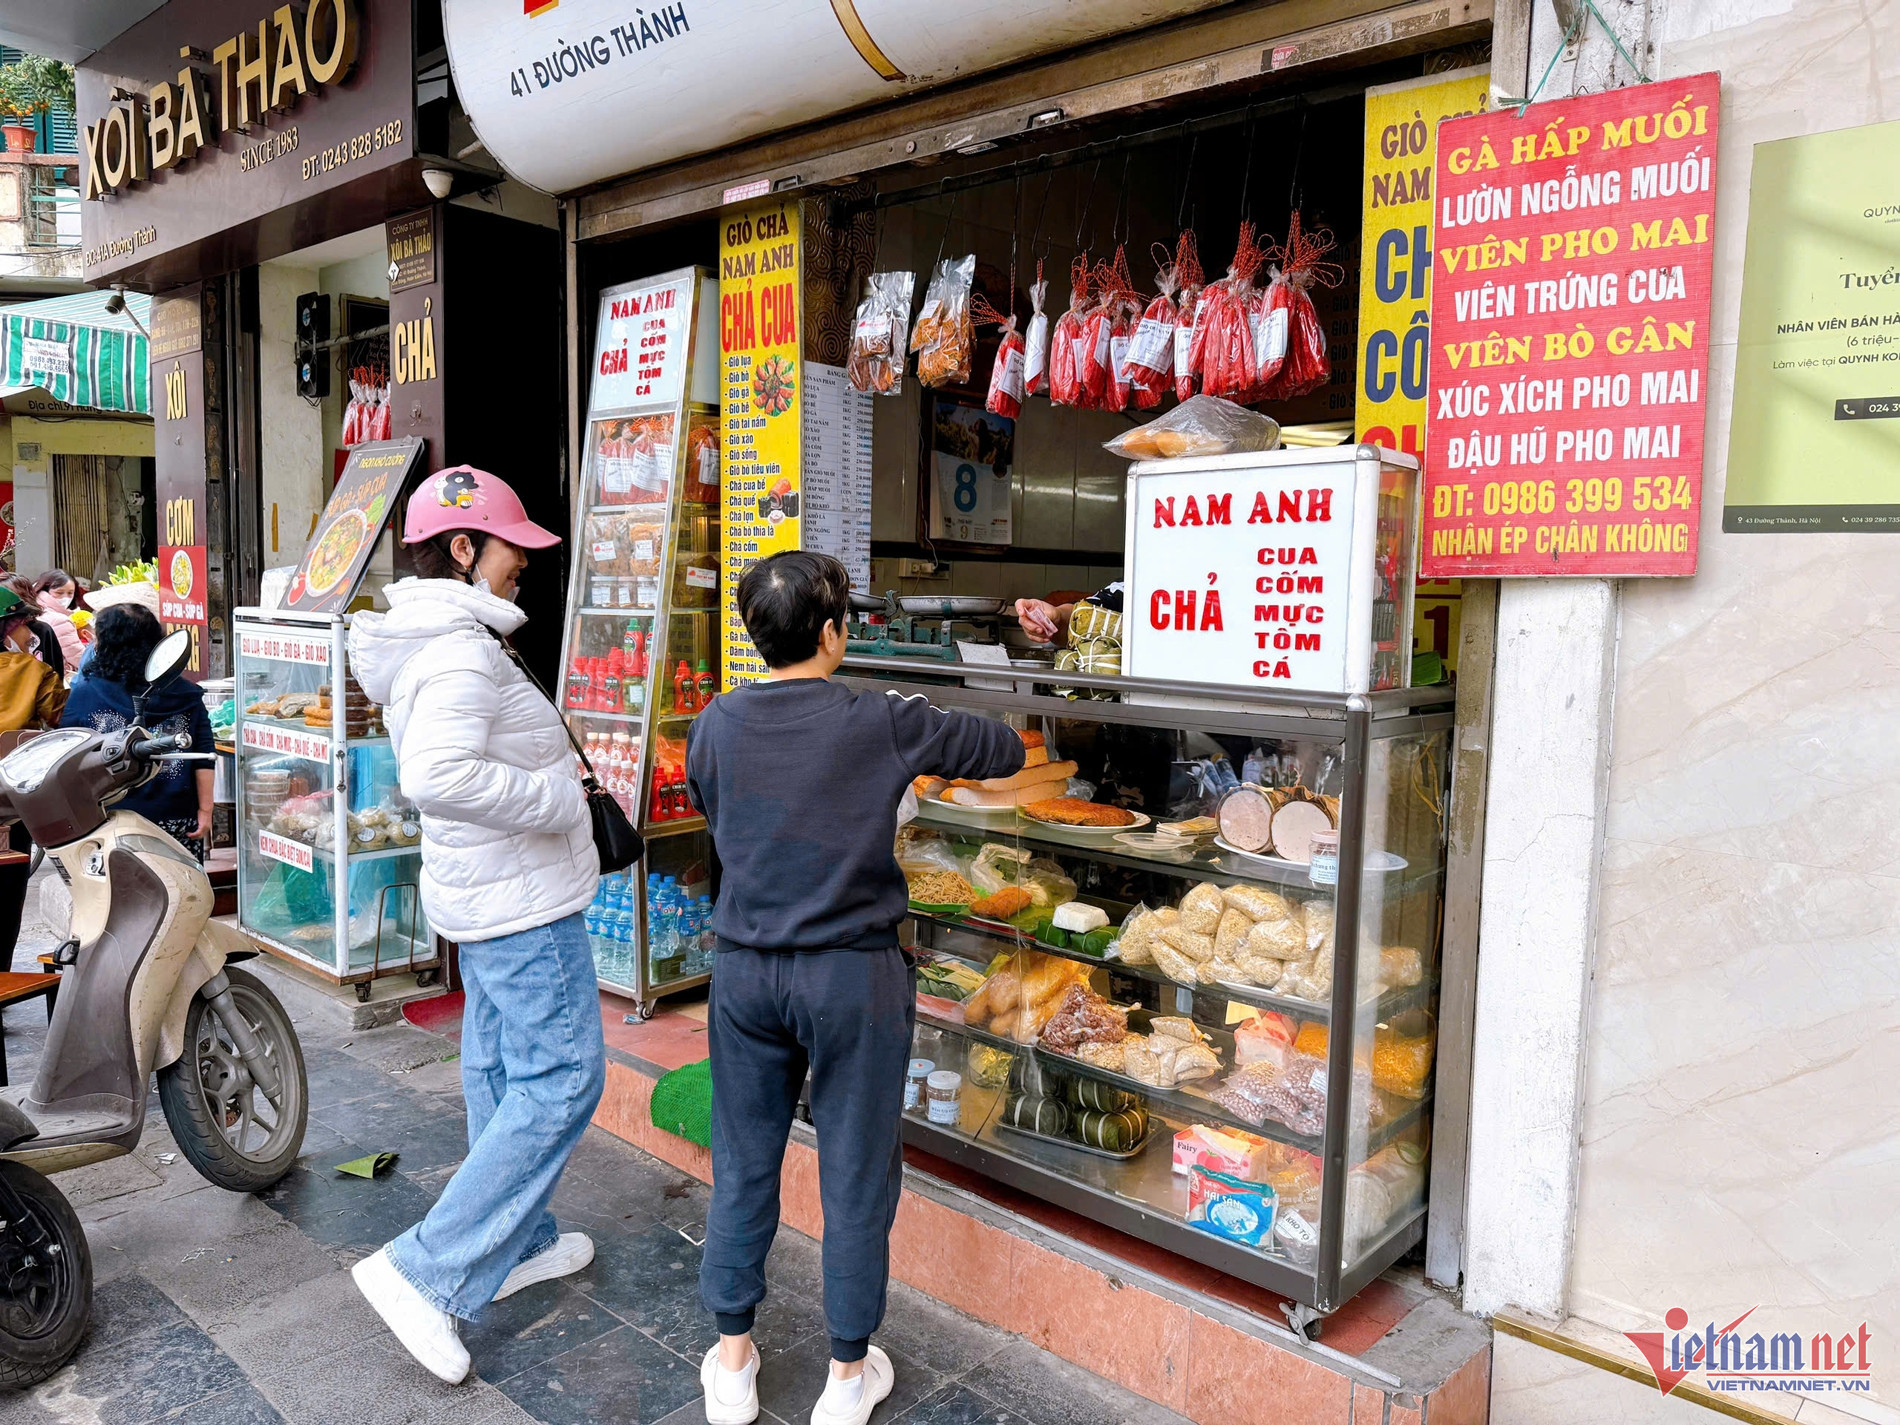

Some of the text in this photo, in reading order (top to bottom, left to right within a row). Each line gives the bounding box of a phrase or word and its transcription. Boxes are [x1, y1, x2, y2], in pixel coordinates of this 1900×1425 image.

[510, 2, 691, 98] 41 ĐƯỜNG THÀNH
[85, 87, 140, 200] XÔI
[149, 46, 205, 170] BÀ
[1381, 110, 1427, 159] GIÒ
[1448, 94, 1709, 175] GÀ HẤP MUỐI
[240, 126, 298, 172] SINCE 1983
[302, 119, 402, 181] ĐT: 0243 828 5182
[1371, 166, 1431, 209] NAM
[1442, 145, 1711, 228] LƯỜN NGỖNG MUỐI
[726, 203, 789, 247] GIÒ CHẢ
[391, 228, 431, 261] XÔI BÀ THẢO
[1439, 214, 1709, 274] VIÊN PHO MAI
[722, 243, 794, 280] NAM ANH
[1375, 225, 1432, 303] CH
[611, 289, 676, 320] NAM ANH
[1454, 266, 1686, 322] VIÊN TRỨNG CUA
[643, 319, 665, 332] CUA
[721, 278, 796, 353] CHẢ CUA
[1777, 320, 1813, 334] NHÂN
[1817, 318, 1846, 331] VIÊN
[1851, 314, 1878, 328] BÁN
[394, 297, 436, 385] CHẢ
[641, 331, 666, 348] CỐM
[1444, 315, 1696, 370] VIÊN BÒ GÂN
[1847, 335, 1859, 348] (6
[600, 338, 628, 376] CHẢ
[639, 351, 665, 365] MỰC
[729, 356, 751, 368] Giò lụa
[1365, 310, 1429, 403] CÔ
[1772, 361, 1795, 369] Làm
[1798, 359, 1819, 369] việc
[1822, 357, 1836, 367] tại
[1838, 354, 1879, 365] QUYNH
[638, 365, 662, 380] TÔM
[729, 371, 749, 383] Giò bò
[165, 361, 187, 420] XÔI
[636, 381, 650, 396] CÁ
[729, 387, 750, 400] Giò gà
[1437, 369, 1699, 420] XÚC XÍCH PHO MAI
[729, 403, 740, 414] Giò
[1869, 404, 1889, 413] 024
[729, 414, 766, 429] Giò tai nấm
[729, 433, 754, 445] Giò xào
[1447, 429, 1501, 475] ĐẬU
[1510, 426, 1547, 465] HŨ
[1556, 428, 1613, 463] PHO
[1623, 425, 1681, 459] MAI
[729, 446, 757, 461] Giò sống
[729, 462, 780, 476] Giò bò tiêu viên
[729, 479, 756, 491] Chả cua
[954, 464, 977, 512] 8
[729, 492, 756, 507] Chả quế
[1433, 475, 1692, 518] ĐT: 0986 399 534
[729, 509, 754, 523] Chả lợn
[1153, 488, 1333, 528] NAM ANH
[166, 495, 194, 546] CƠM
[729, 524, 774, 536] Chả bò là
[1754, 517, 1774, 525] Đường
[1809, 517, 1821, 525] Nội
[960, 525, 969, 539] 9
[1432, 518, 1688, 561] NHẬN ÉP CHÂN KHÔNG
[729, 539, 757, 551] Chả cốm
[1257, 547, 1318, 565] CUA
[729, 555, 742, 566] Chả
[729, 571, 739, 581] Ch
[1255, 570, 1323, 594] CỐM
[1150, 572, 1224, 632] CHẢ
[1254, 604, 1324, 626] MỰC
[729, 631, 738, 641] Gà
[1254, 627, 1320, 651] TÔM
[729, 661, 744, 672] Nem
[1253, 656, 1291, 678] CÁ
[729, 675, 738, 686] Cá
[1177, 1142, 1197, 1153] Fairy
[1285, 1217, 1300, 1229] KHO
